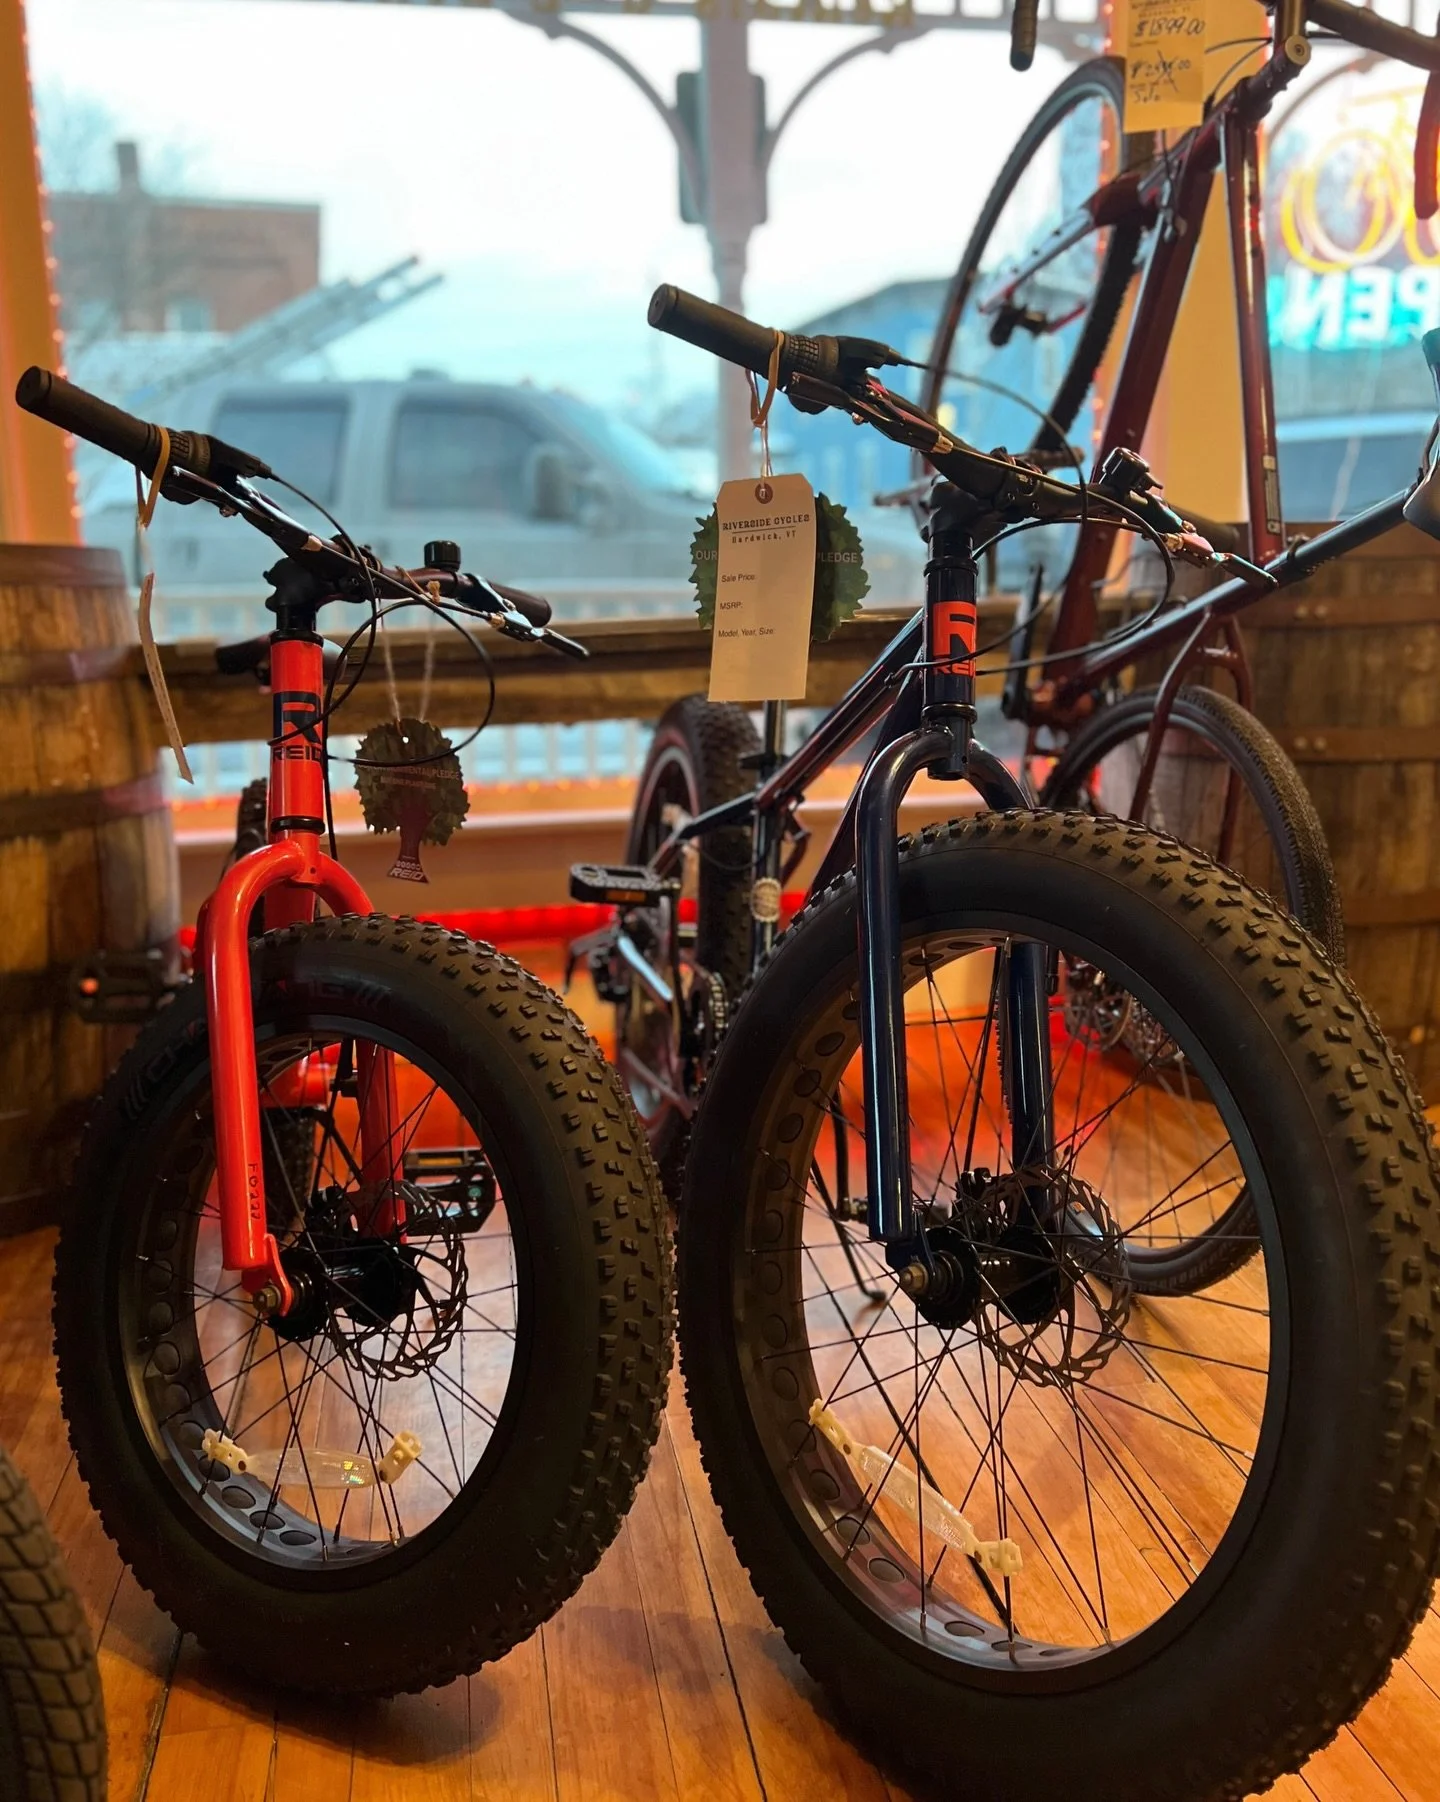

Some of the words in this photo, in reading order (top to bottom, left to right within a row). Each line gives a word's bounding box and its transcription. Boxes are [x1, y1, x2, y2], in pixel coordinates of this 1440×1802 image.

[722, 518, 771, 531] RIVERSIDE
[774, 513, 810, 525] CYCLES
[732, 533, 781, 544] Hardwick,
[786, 530, 796, 539] VT
[695, 550, 718, 561] OUR
[721, 573, 736, 583] Sale
[720, 601, 743, 610] MSRP:
[390, 867, 424, 881] REID
